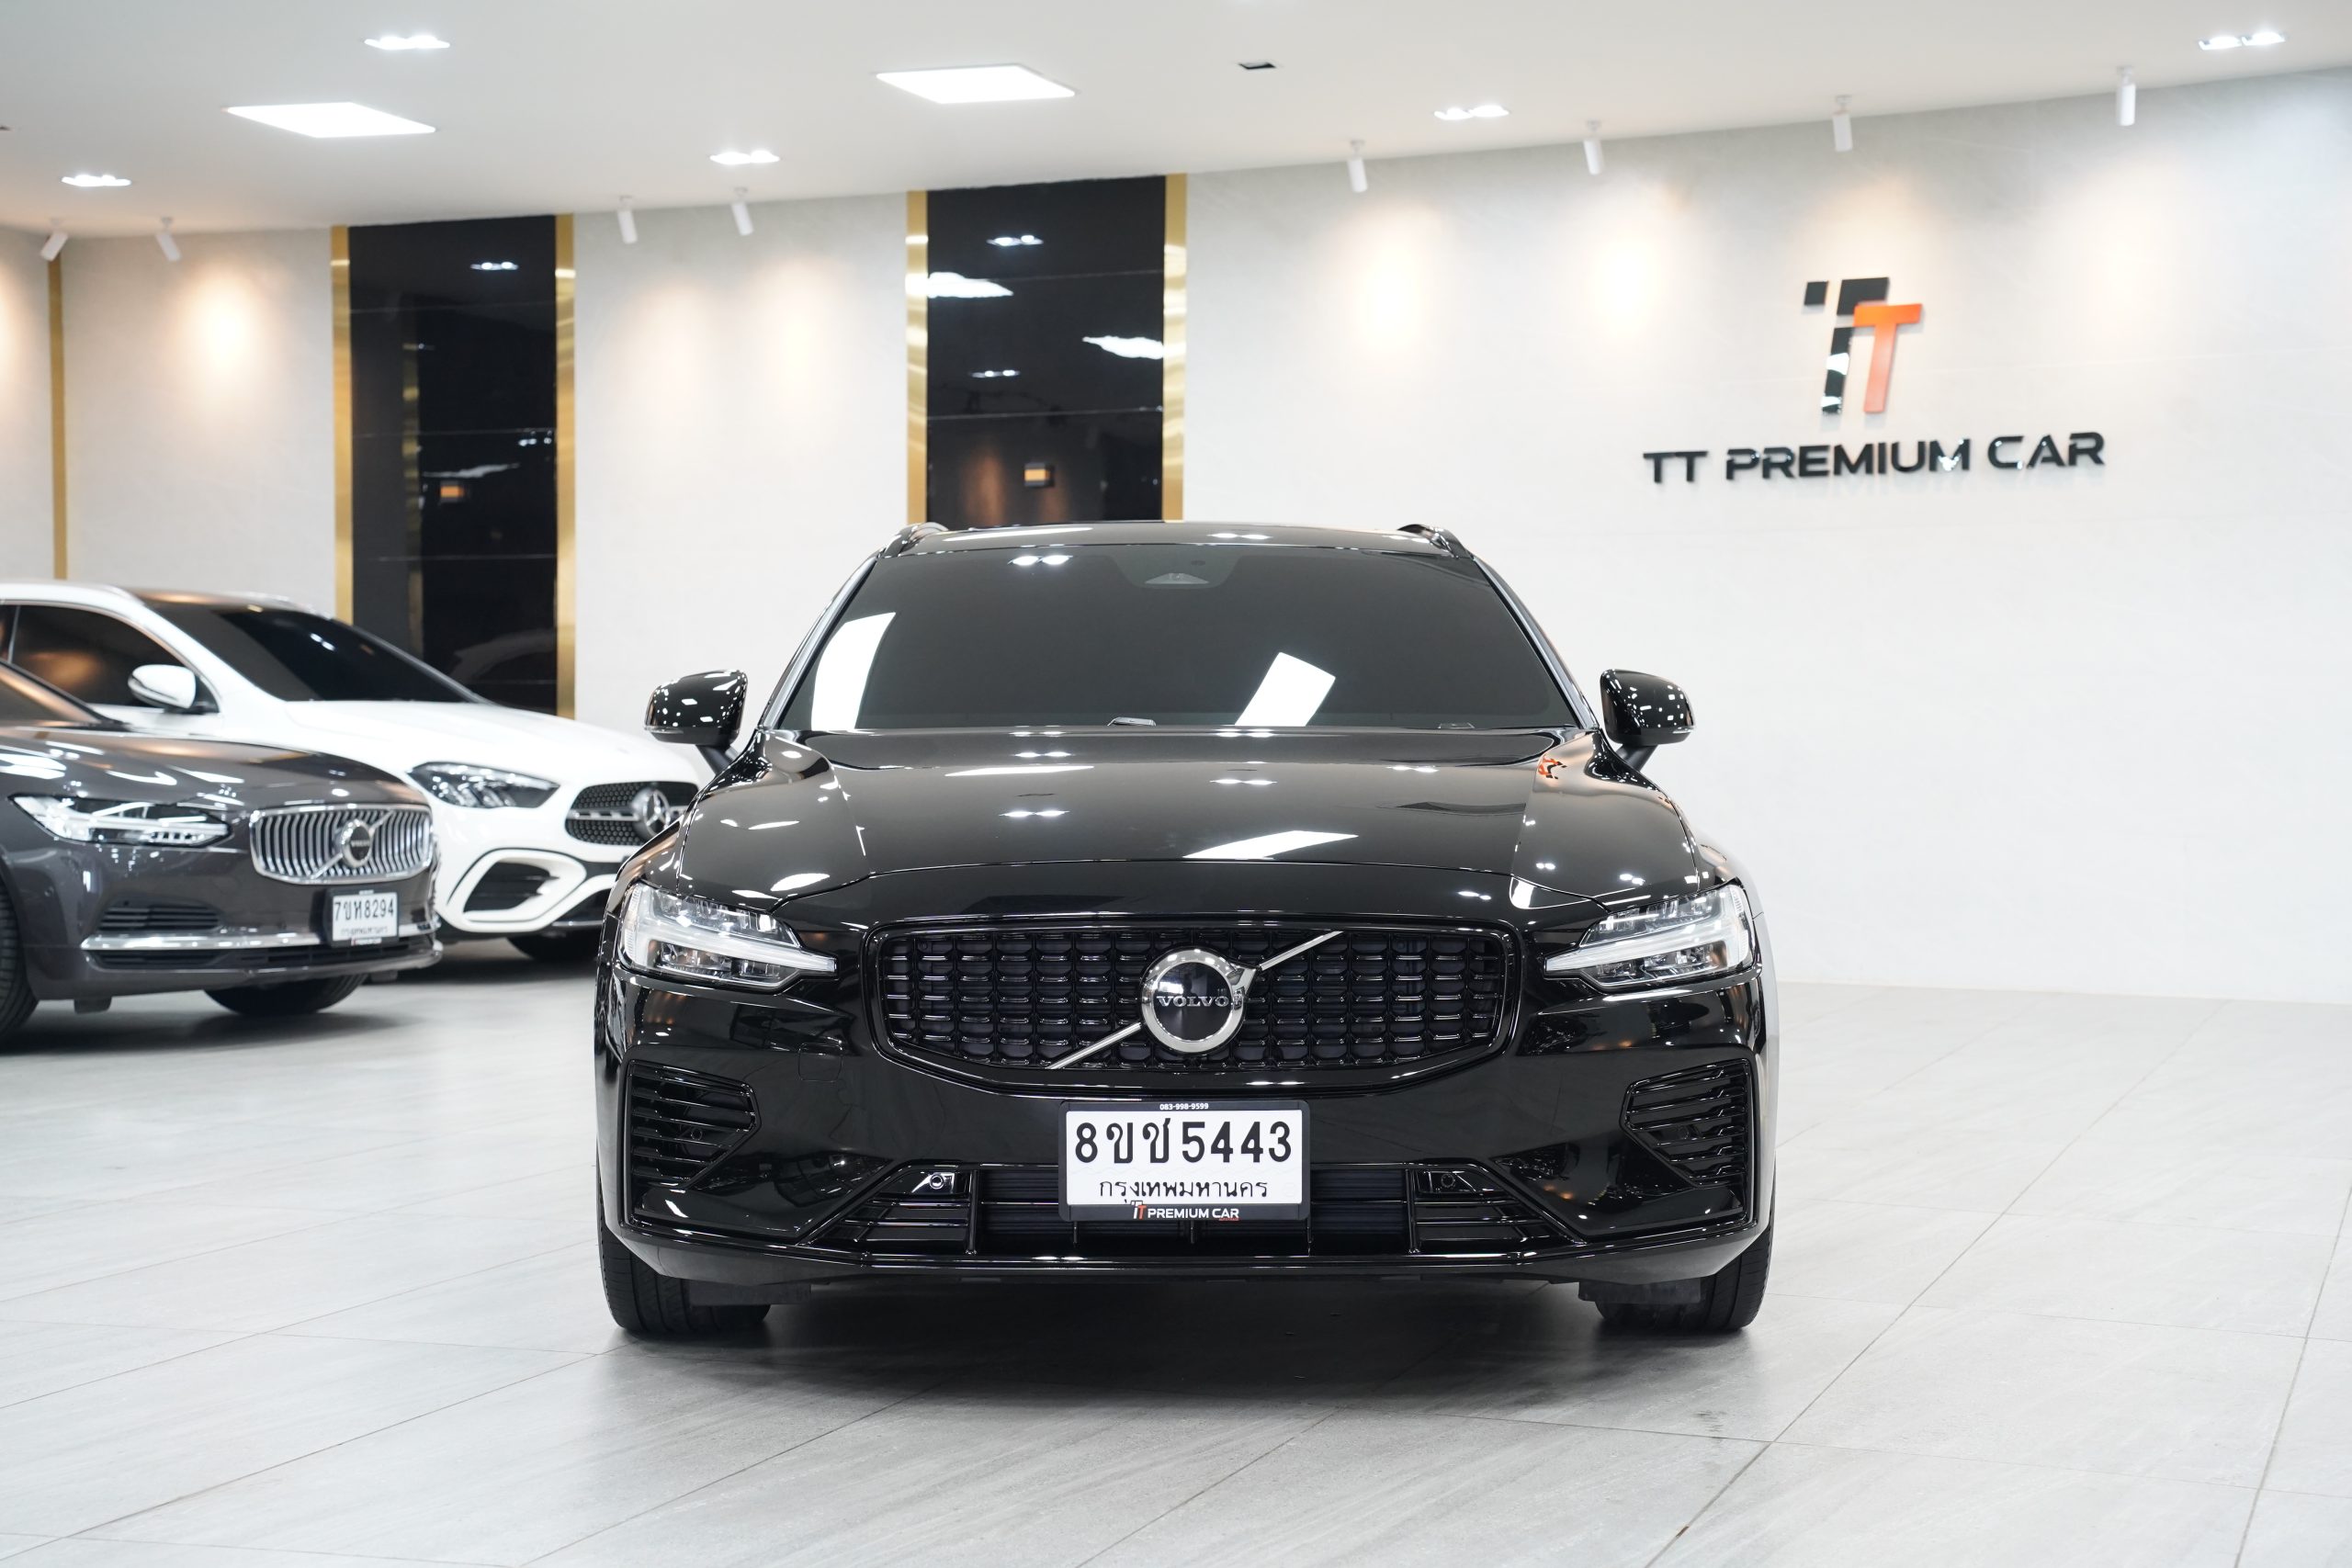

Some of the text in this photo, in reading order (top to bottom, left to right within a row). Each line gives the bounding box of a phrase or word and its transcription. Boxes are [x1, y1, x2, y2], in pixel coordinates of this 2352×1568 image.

[1643, 432, 2106, 483] TT PREMIUM CAR
[1156, 996, 1229, 1007] VOLVO
[1100, 1181, 1268, 1203] กรุงเทพมหานคร
[1148, 1208, 1209, 1218] PREMIUM
[1212, 1208, 1239, 1219] CAR
